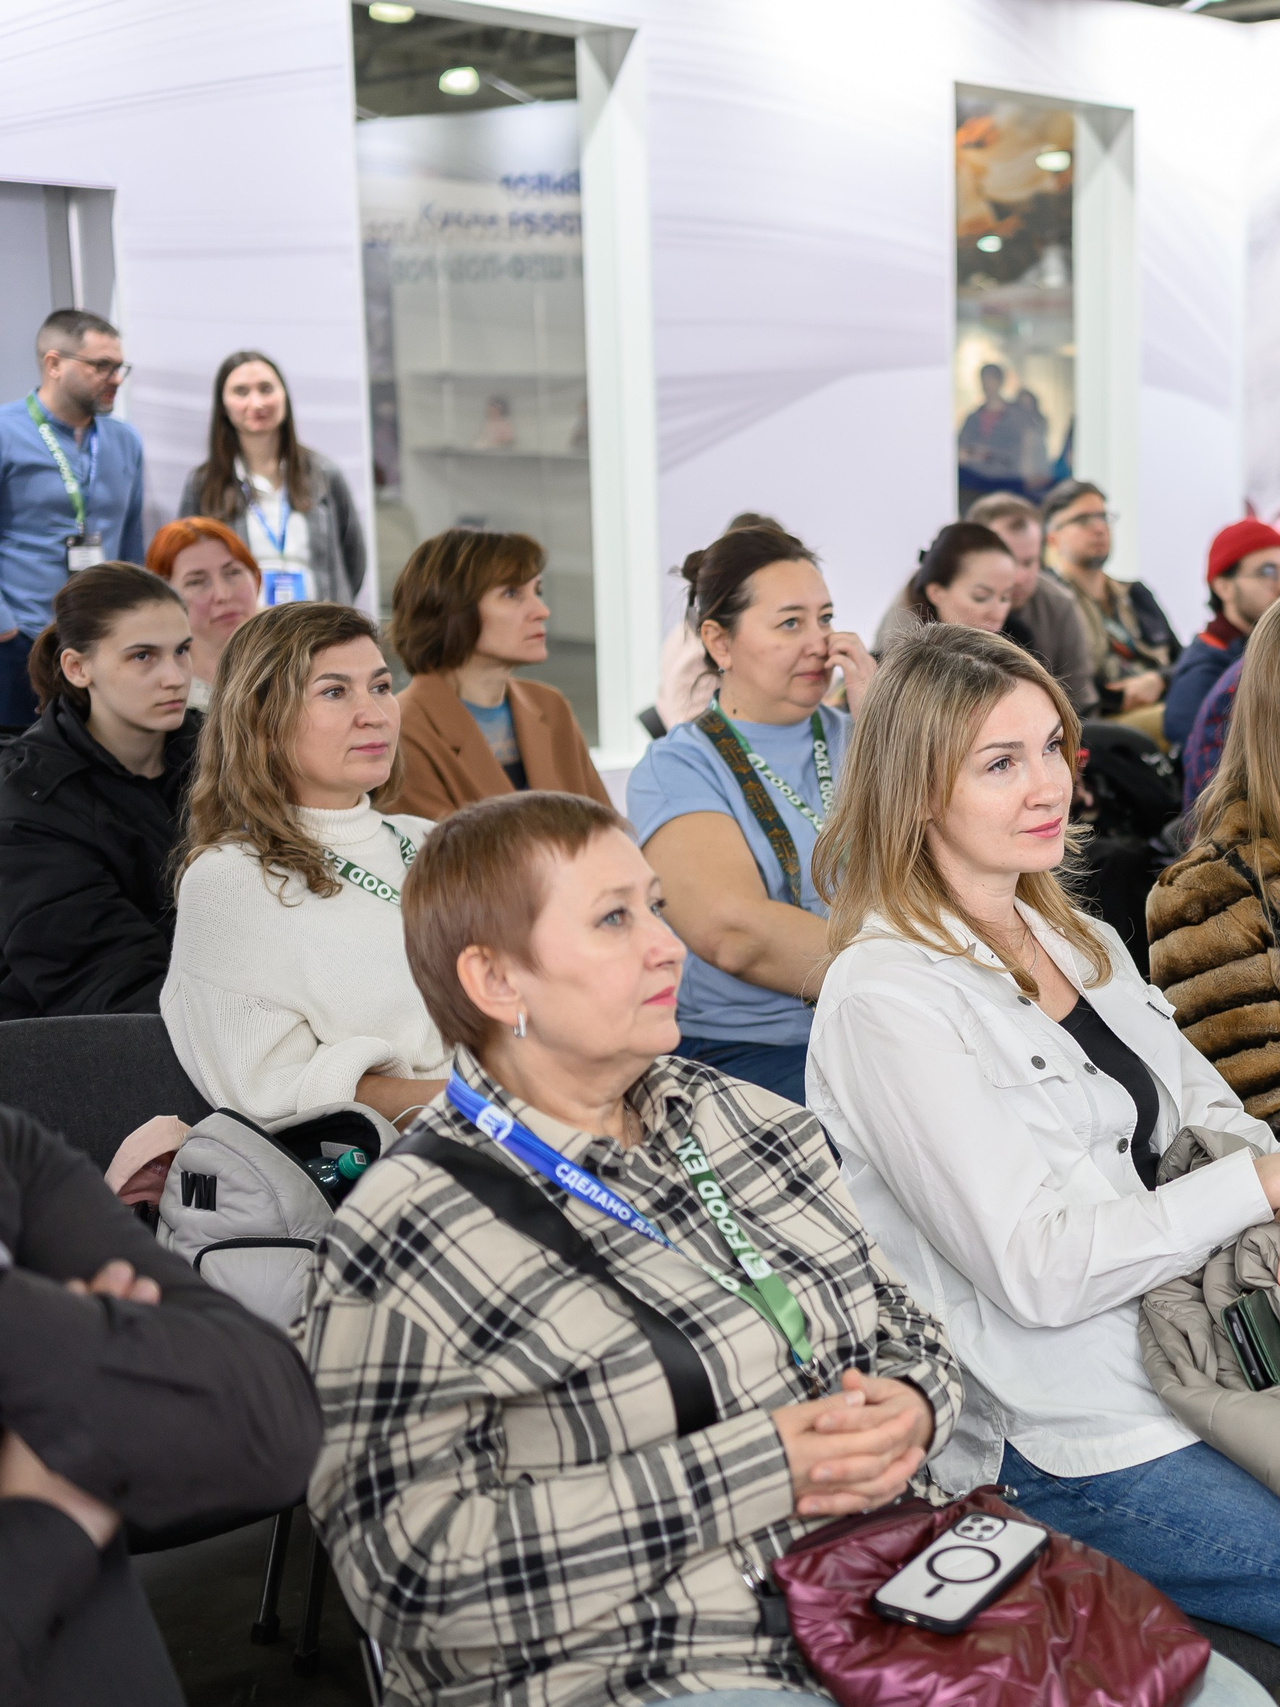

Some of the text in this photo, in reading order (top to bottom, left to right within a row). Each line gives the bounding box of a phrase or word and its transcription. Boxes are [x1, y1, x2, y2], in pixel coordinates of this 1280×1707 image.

[762, 769, 801, 807] FOOD
[675, 1136, 710, 1176] EX
[554, 1162, 632, 1221] СДЕЛАНО
[697, 1180, 750, 1250] FOOD
